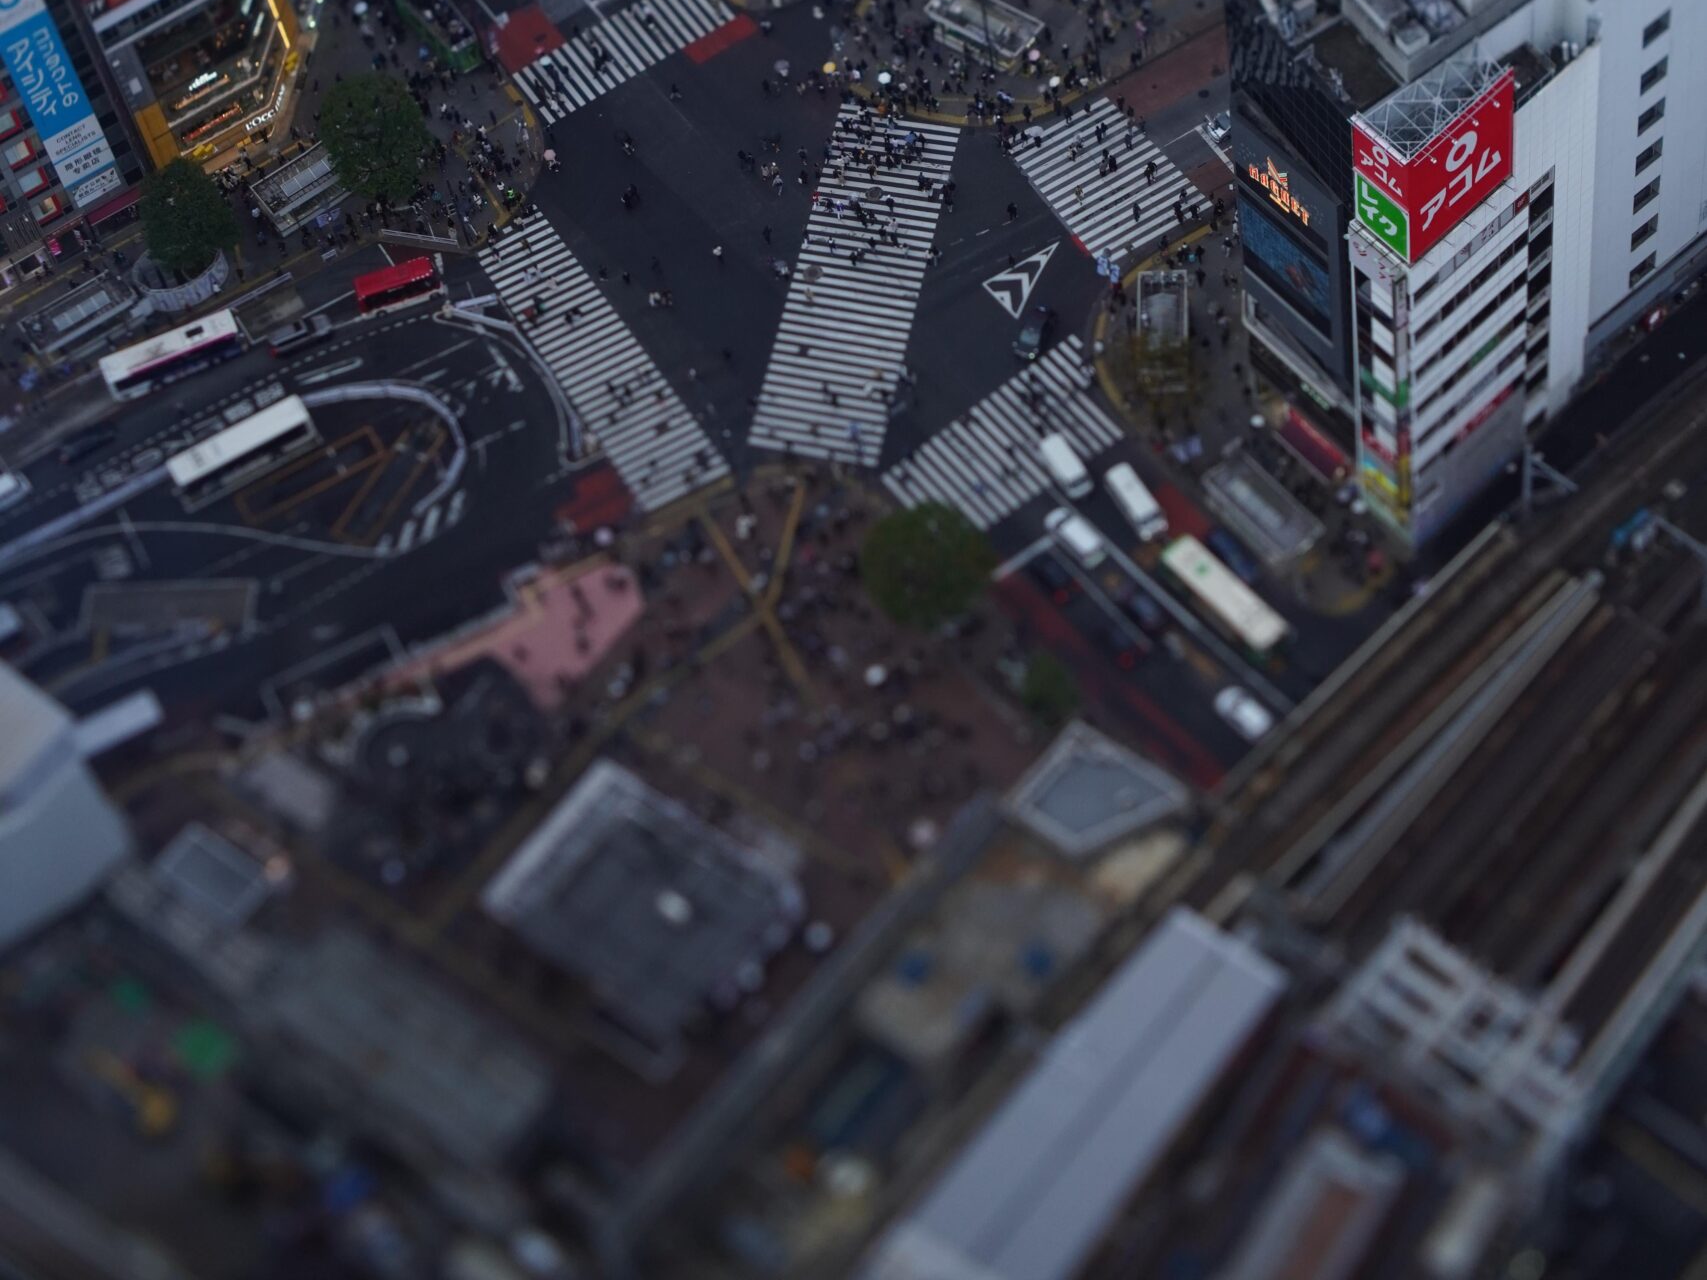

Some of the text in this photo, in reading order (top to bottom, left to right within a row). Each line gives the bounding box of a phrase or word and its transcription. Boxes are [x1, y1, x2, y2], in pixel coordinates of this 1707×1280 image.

[6, 37, 57, 117] アイシティ
[33, 26, 79, 108] コンタクトの
[1360, 149, 1403, 198] アコム
[1360, 181, 1398, 237] レイク
[1420, 147, 1502, 232] アコム
